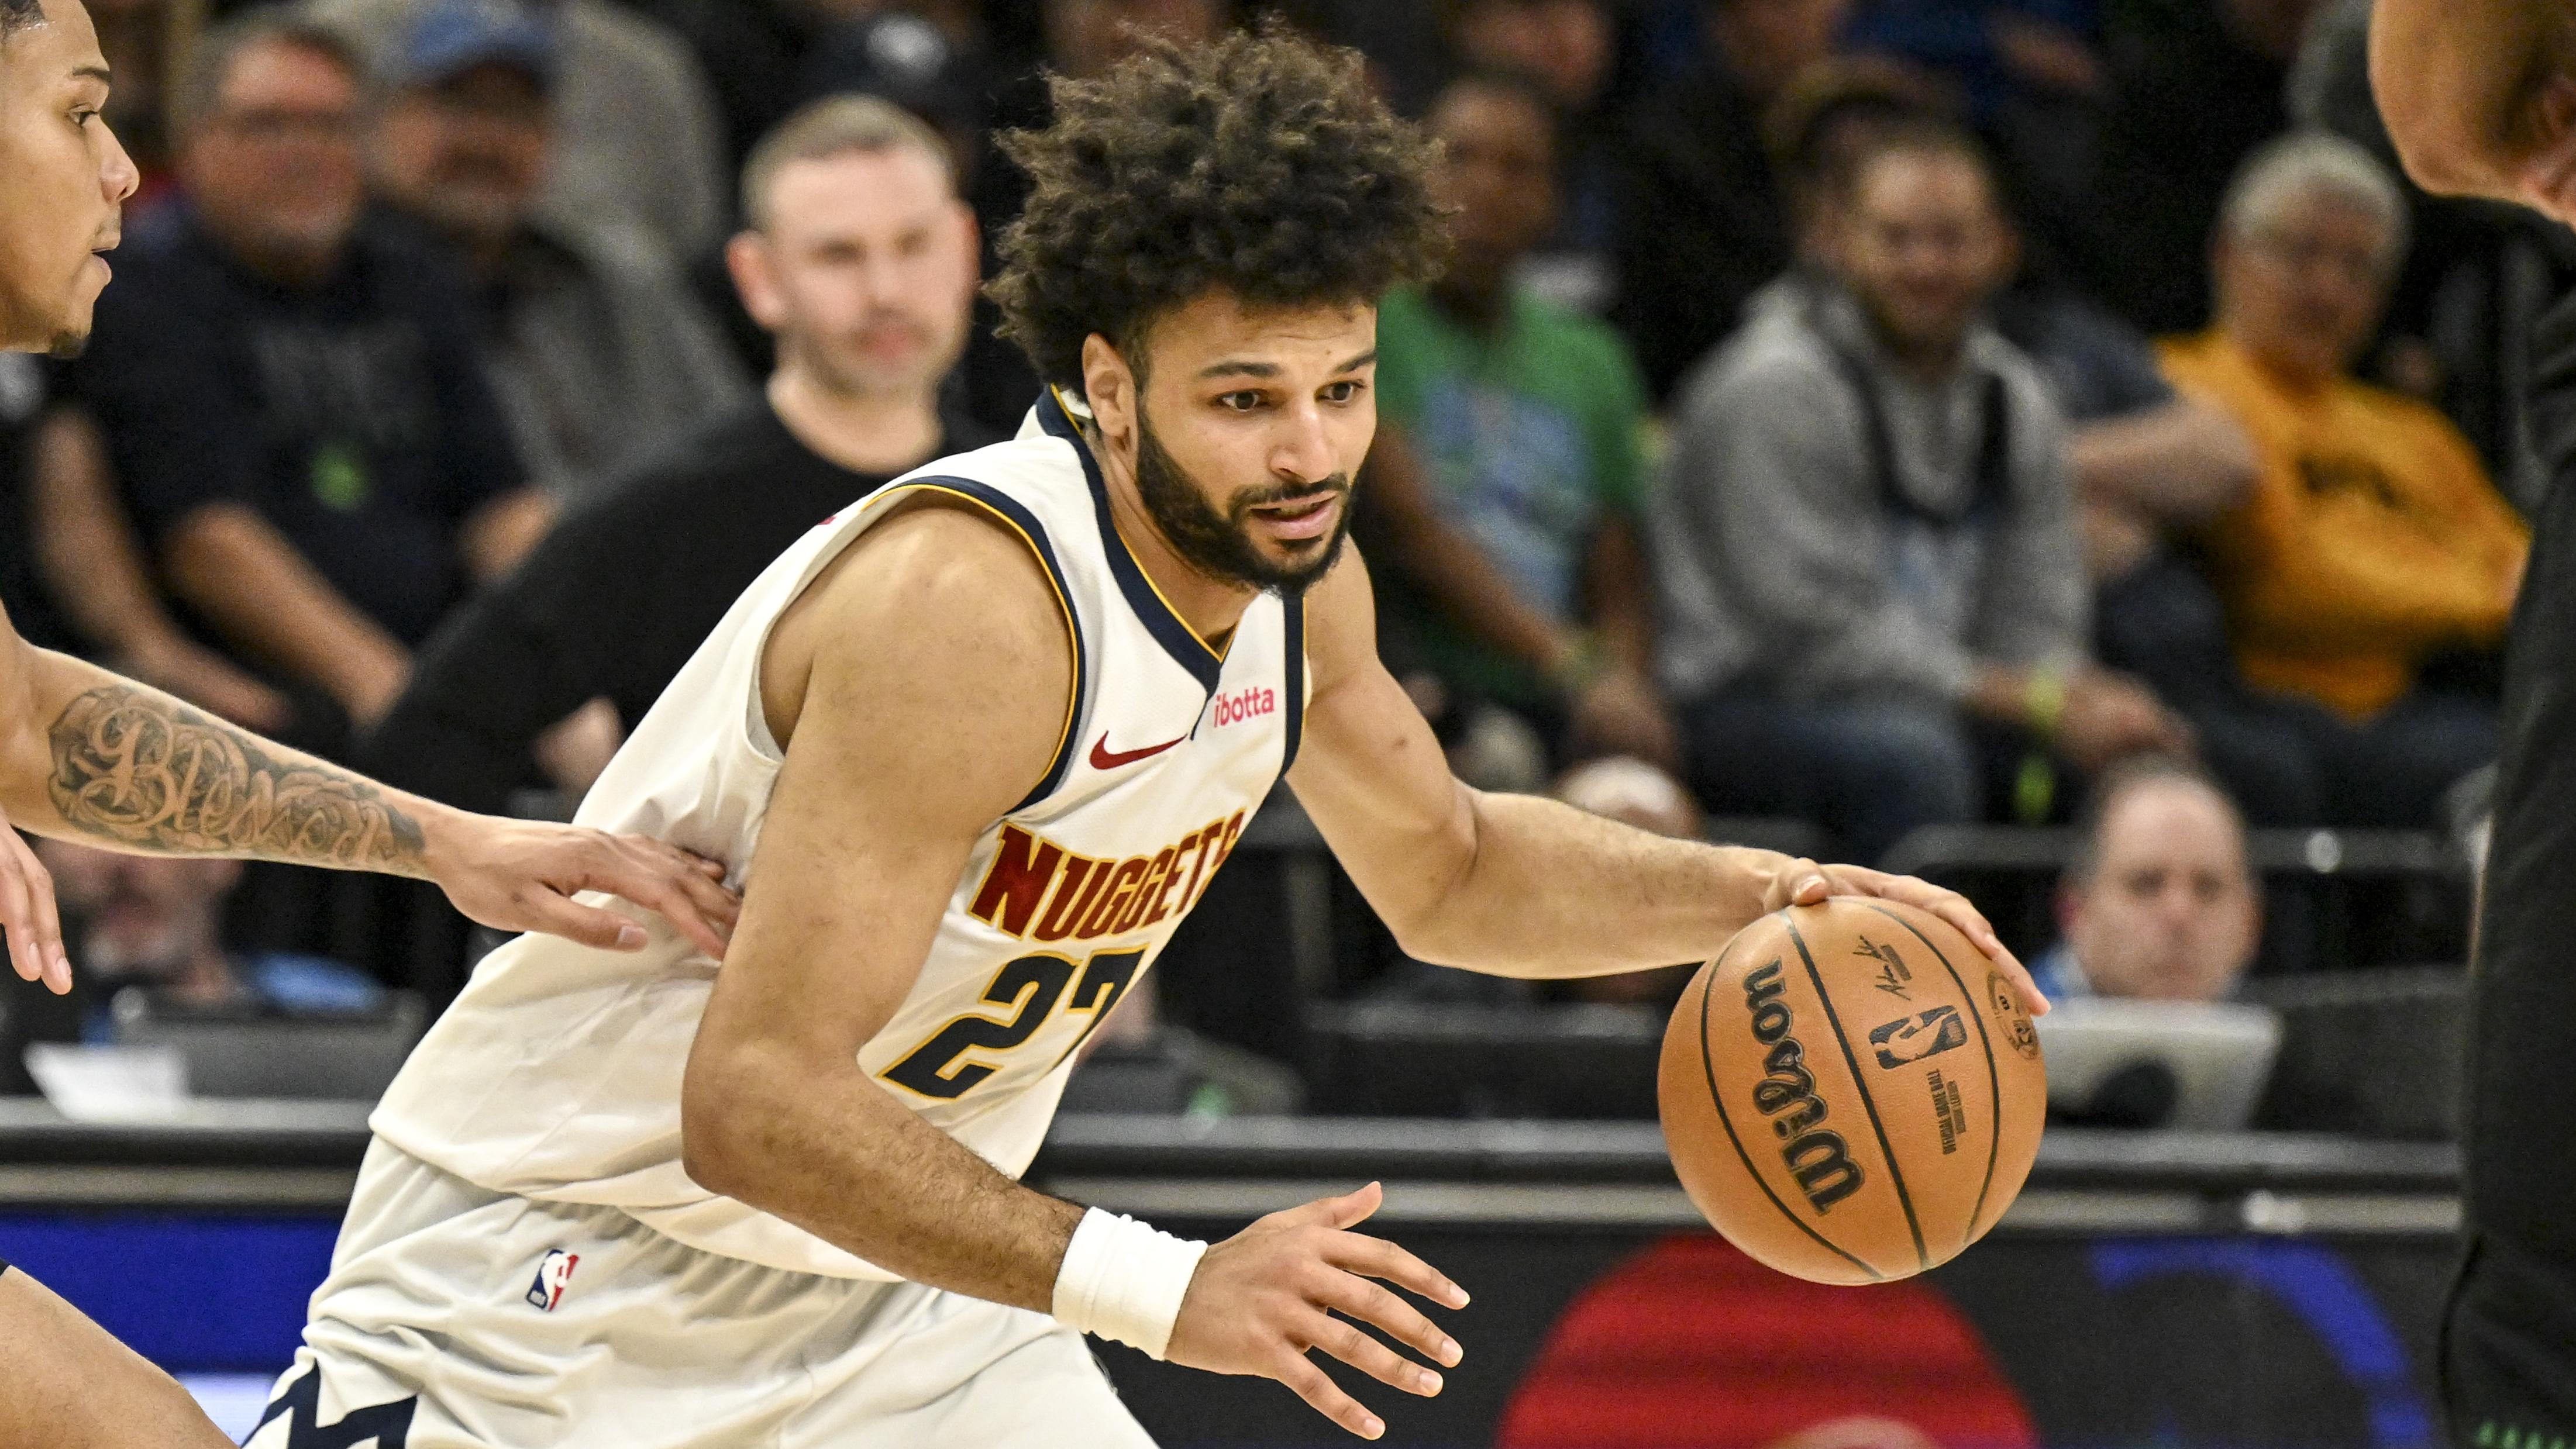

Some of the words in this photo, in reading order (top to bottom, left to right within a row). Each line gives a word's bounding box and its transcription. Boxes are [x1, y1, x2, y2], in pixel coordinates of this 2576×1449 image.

[1213, 685, 1276, 728] ibotta
[874, 943, 1151, 1102] 27
[1742, 956, 1865, 1216] Wilson
